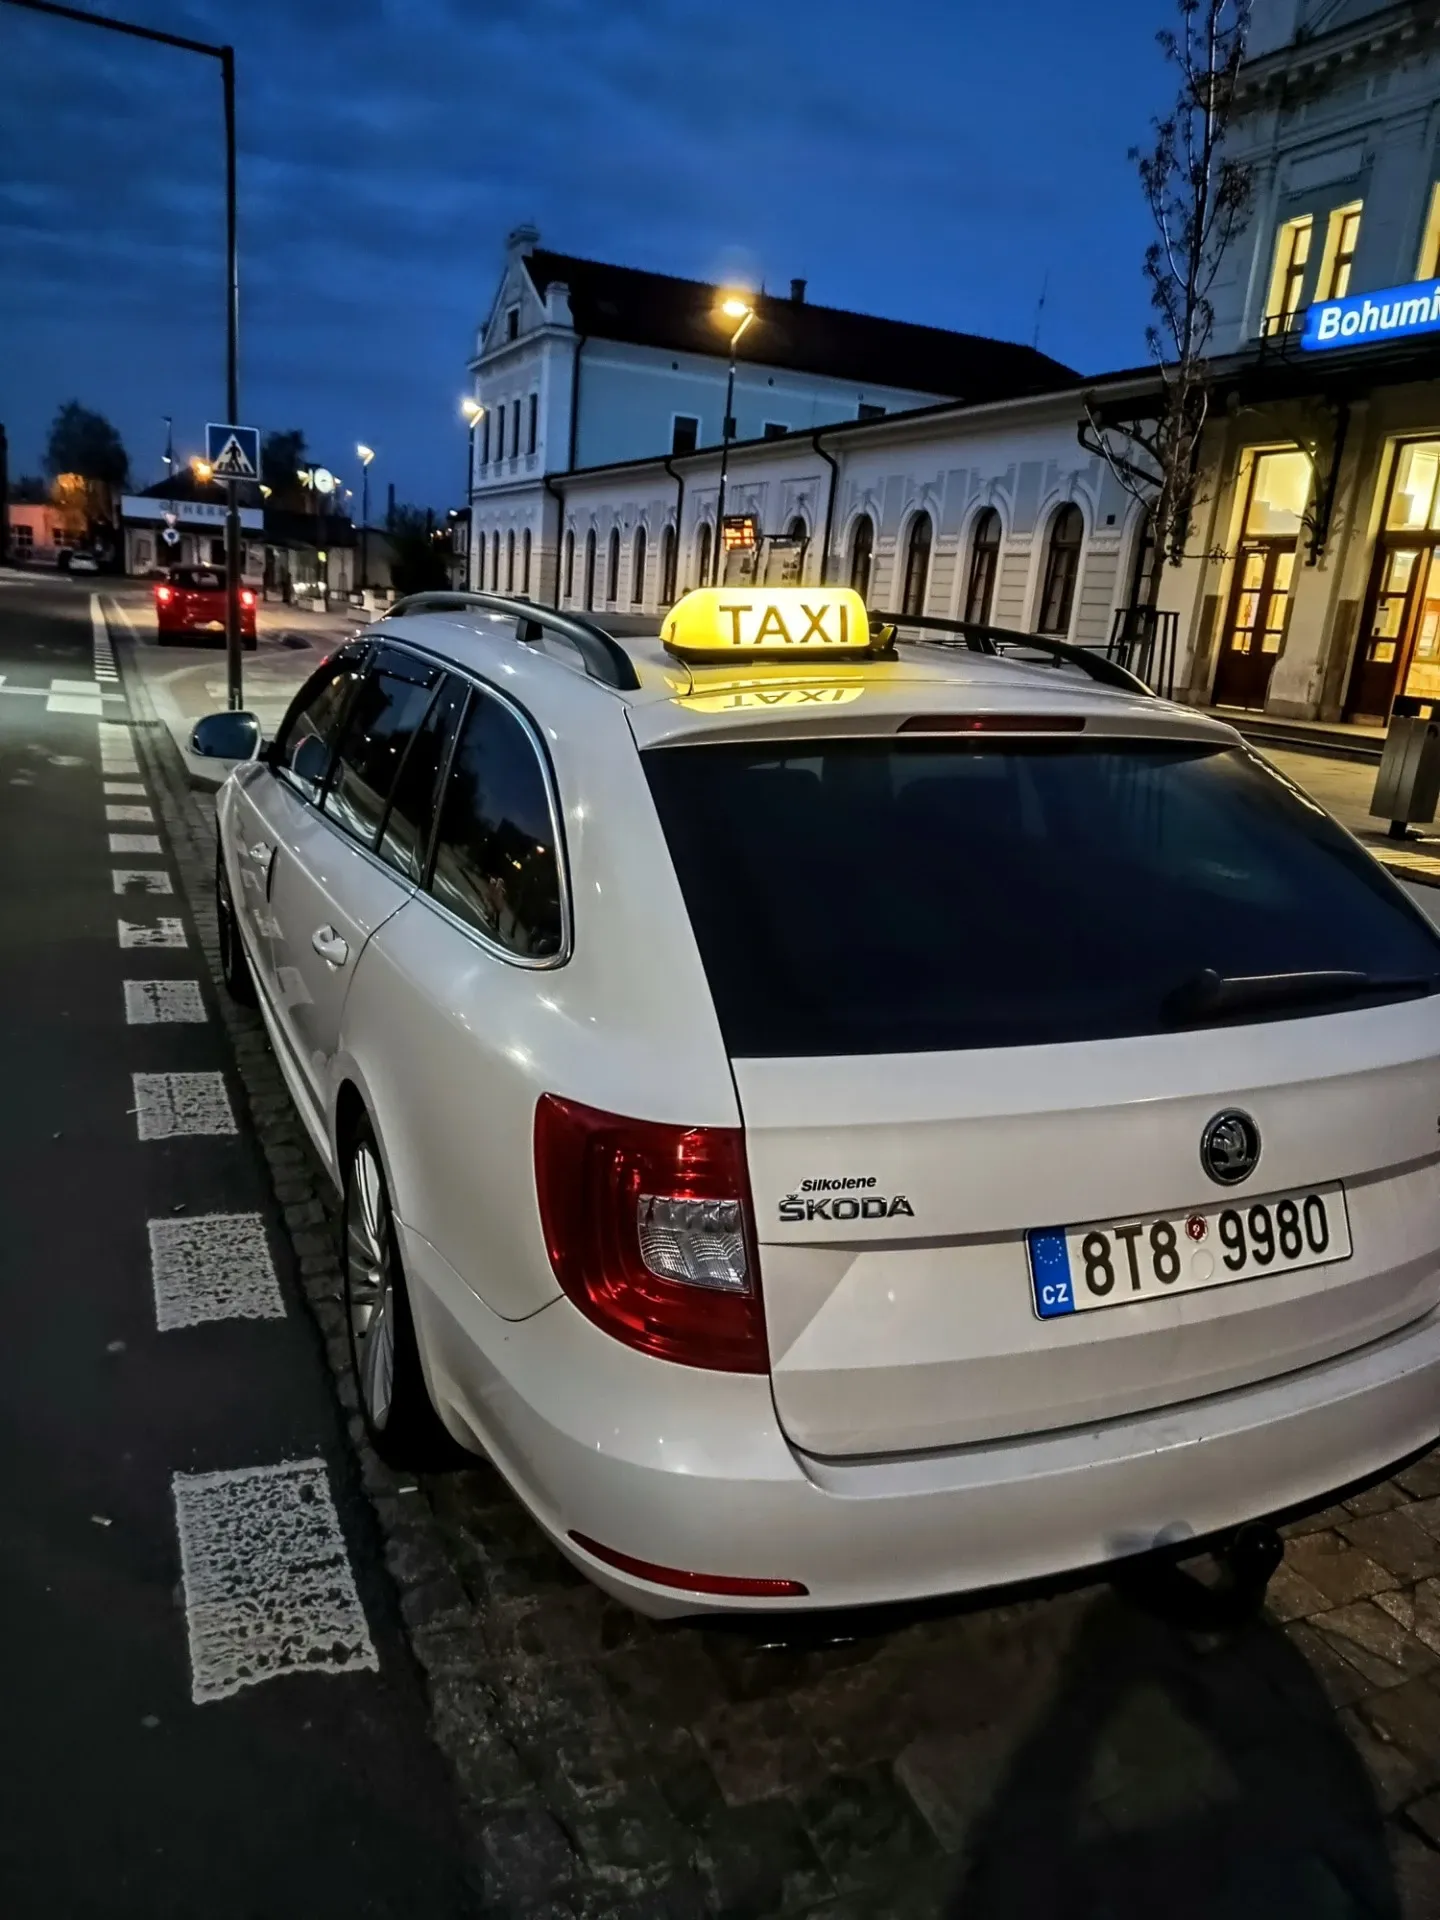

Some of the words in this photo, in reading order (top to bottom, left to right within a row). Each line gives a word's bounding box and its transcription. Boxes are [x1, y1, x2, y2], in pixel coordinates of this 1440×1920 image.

[1317, 285, 1440, 341] Bohumí
[719, 604, 849, 645] TAXI
[801, 1176, 877, 1192] Silkolene
[779, 1194, 915, 1222] ŠKODA
[1081, 1219, 1181, 1296] 8T8
[1219, 1194, 1330, 1271] 9980
[1042, 1282, 1070, 1306] CZ
